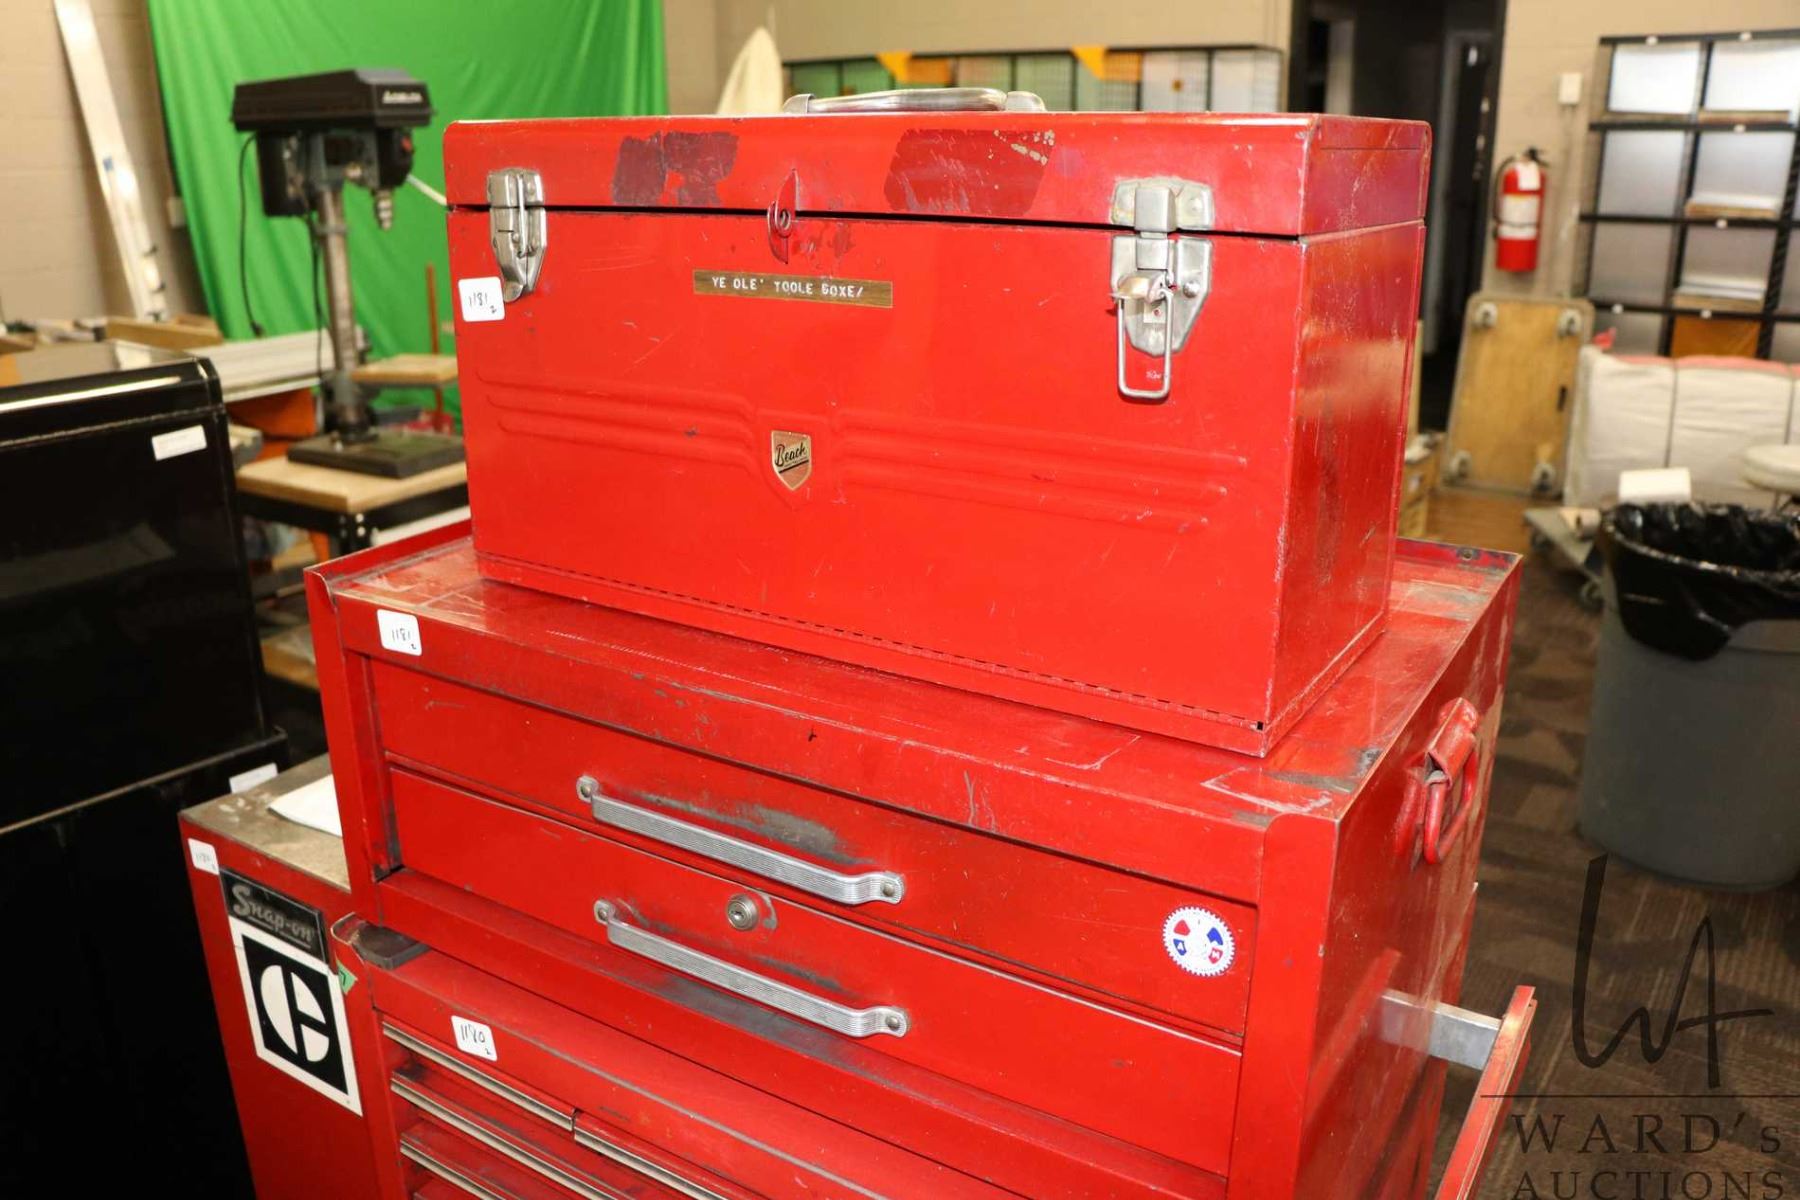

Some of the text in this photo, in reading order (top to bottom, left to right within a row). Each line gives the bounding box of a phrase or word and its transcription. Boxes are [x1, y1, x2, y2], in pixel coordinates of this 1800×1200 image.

[711, 276, 727, 289] YE
[774, 280, 814, 295] TOOLE
[774, 442, 806, 468] Beach
[231, 883, 316, 943] Snap-on
